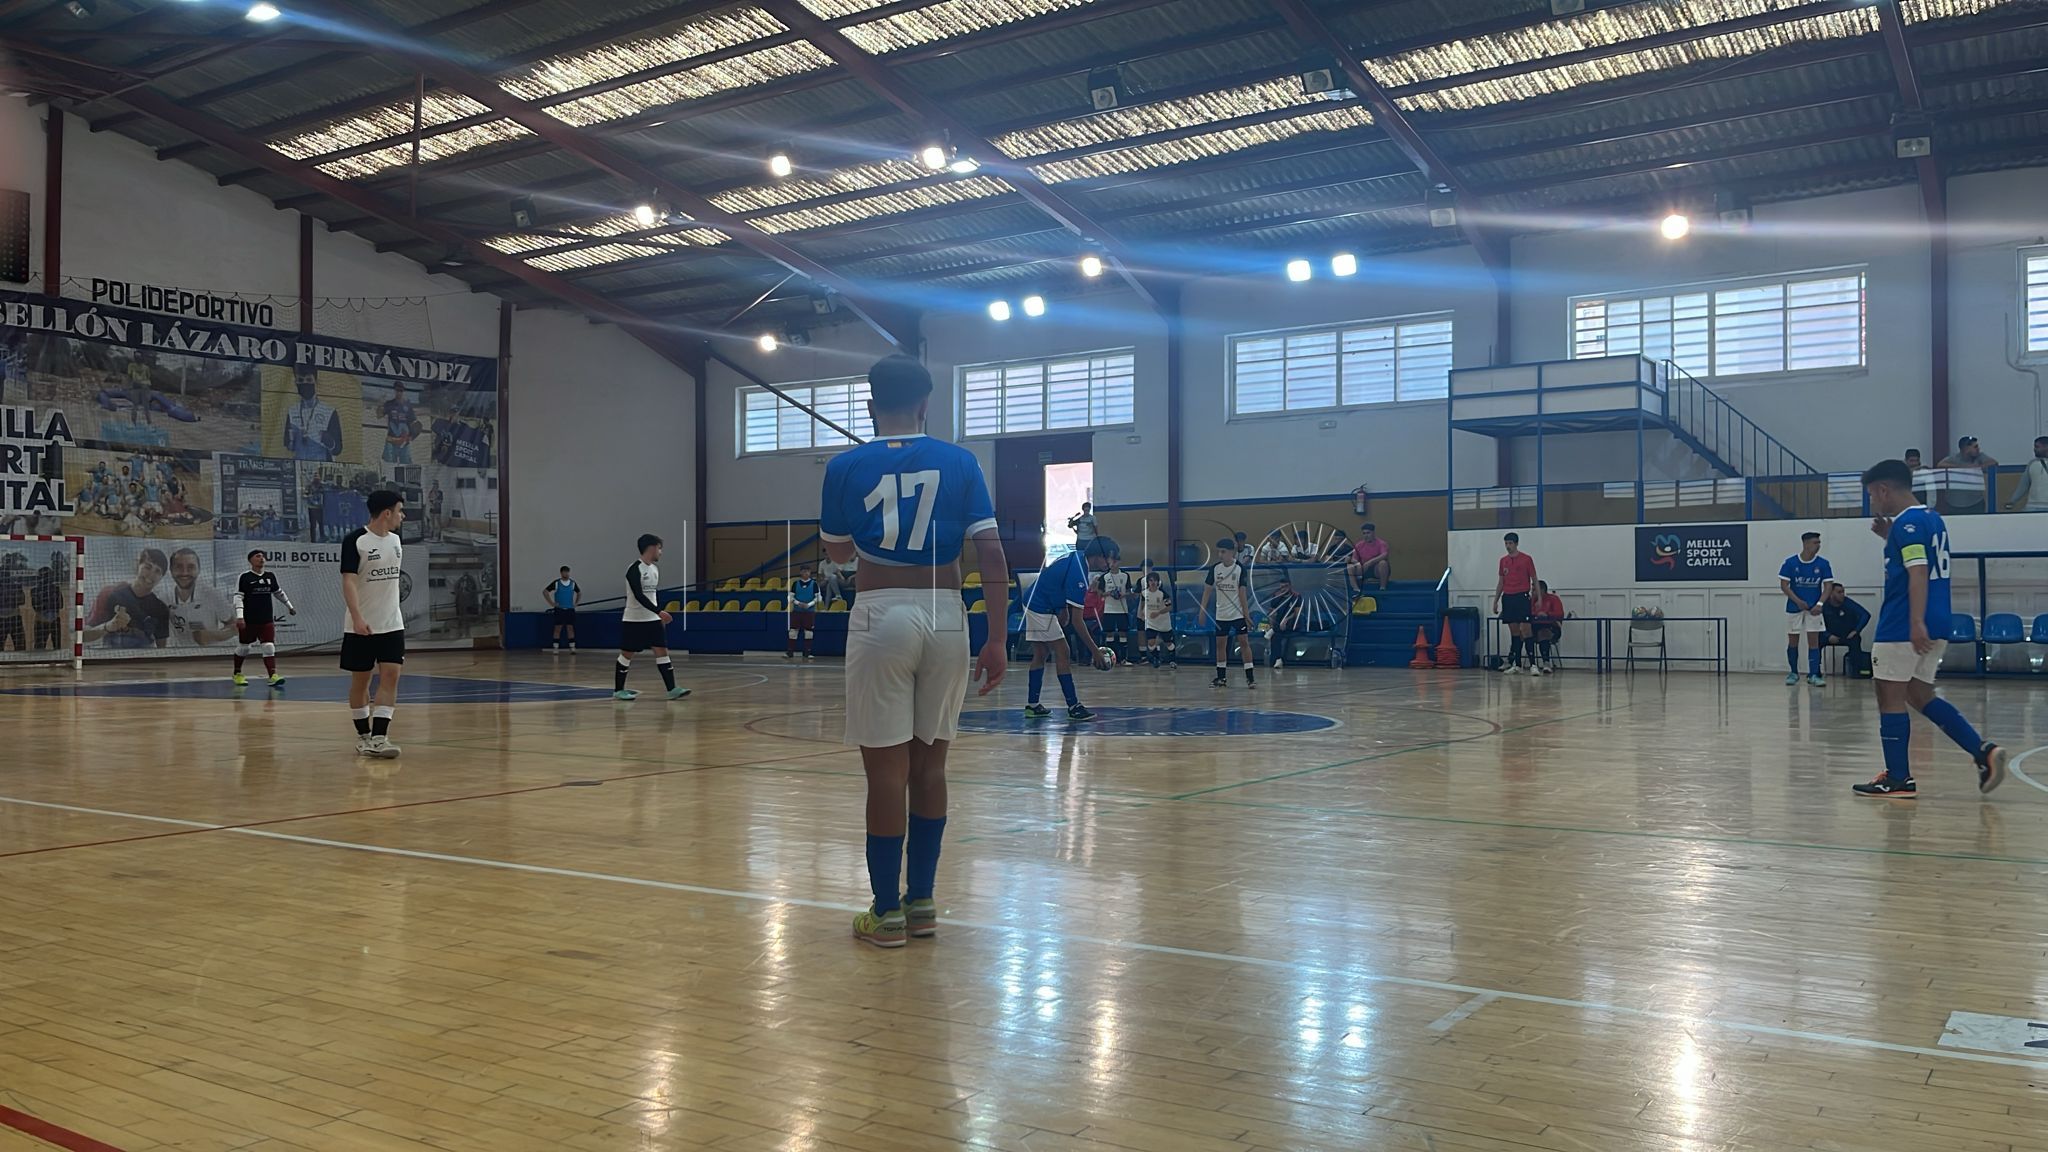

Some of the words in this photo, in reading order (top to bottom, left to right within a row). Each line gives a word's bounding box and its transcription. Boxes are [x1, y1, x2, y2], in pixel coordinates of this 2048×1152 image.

[92, 277, 273, 327] POLIDEPORTIVO
[0, 301, 131, 343] ELLÓN
[141, 320, 287, 362] LÁZARO
[295, 341, 472, 385] FERNÁNDEZ
[0, 407, 74, 442] LLA
[863, 469, 941, 551] 17
[264, 551, 287, 563] URI
[291, 551, 341, 563] BOTELL
[1686, 539, 1731, 548] MELILLA
[1686, 548, 1723, 557] SPORT
[1929, 531, 1951, 581] 16
[1686, 557, 1732, 567] CAPITAL
